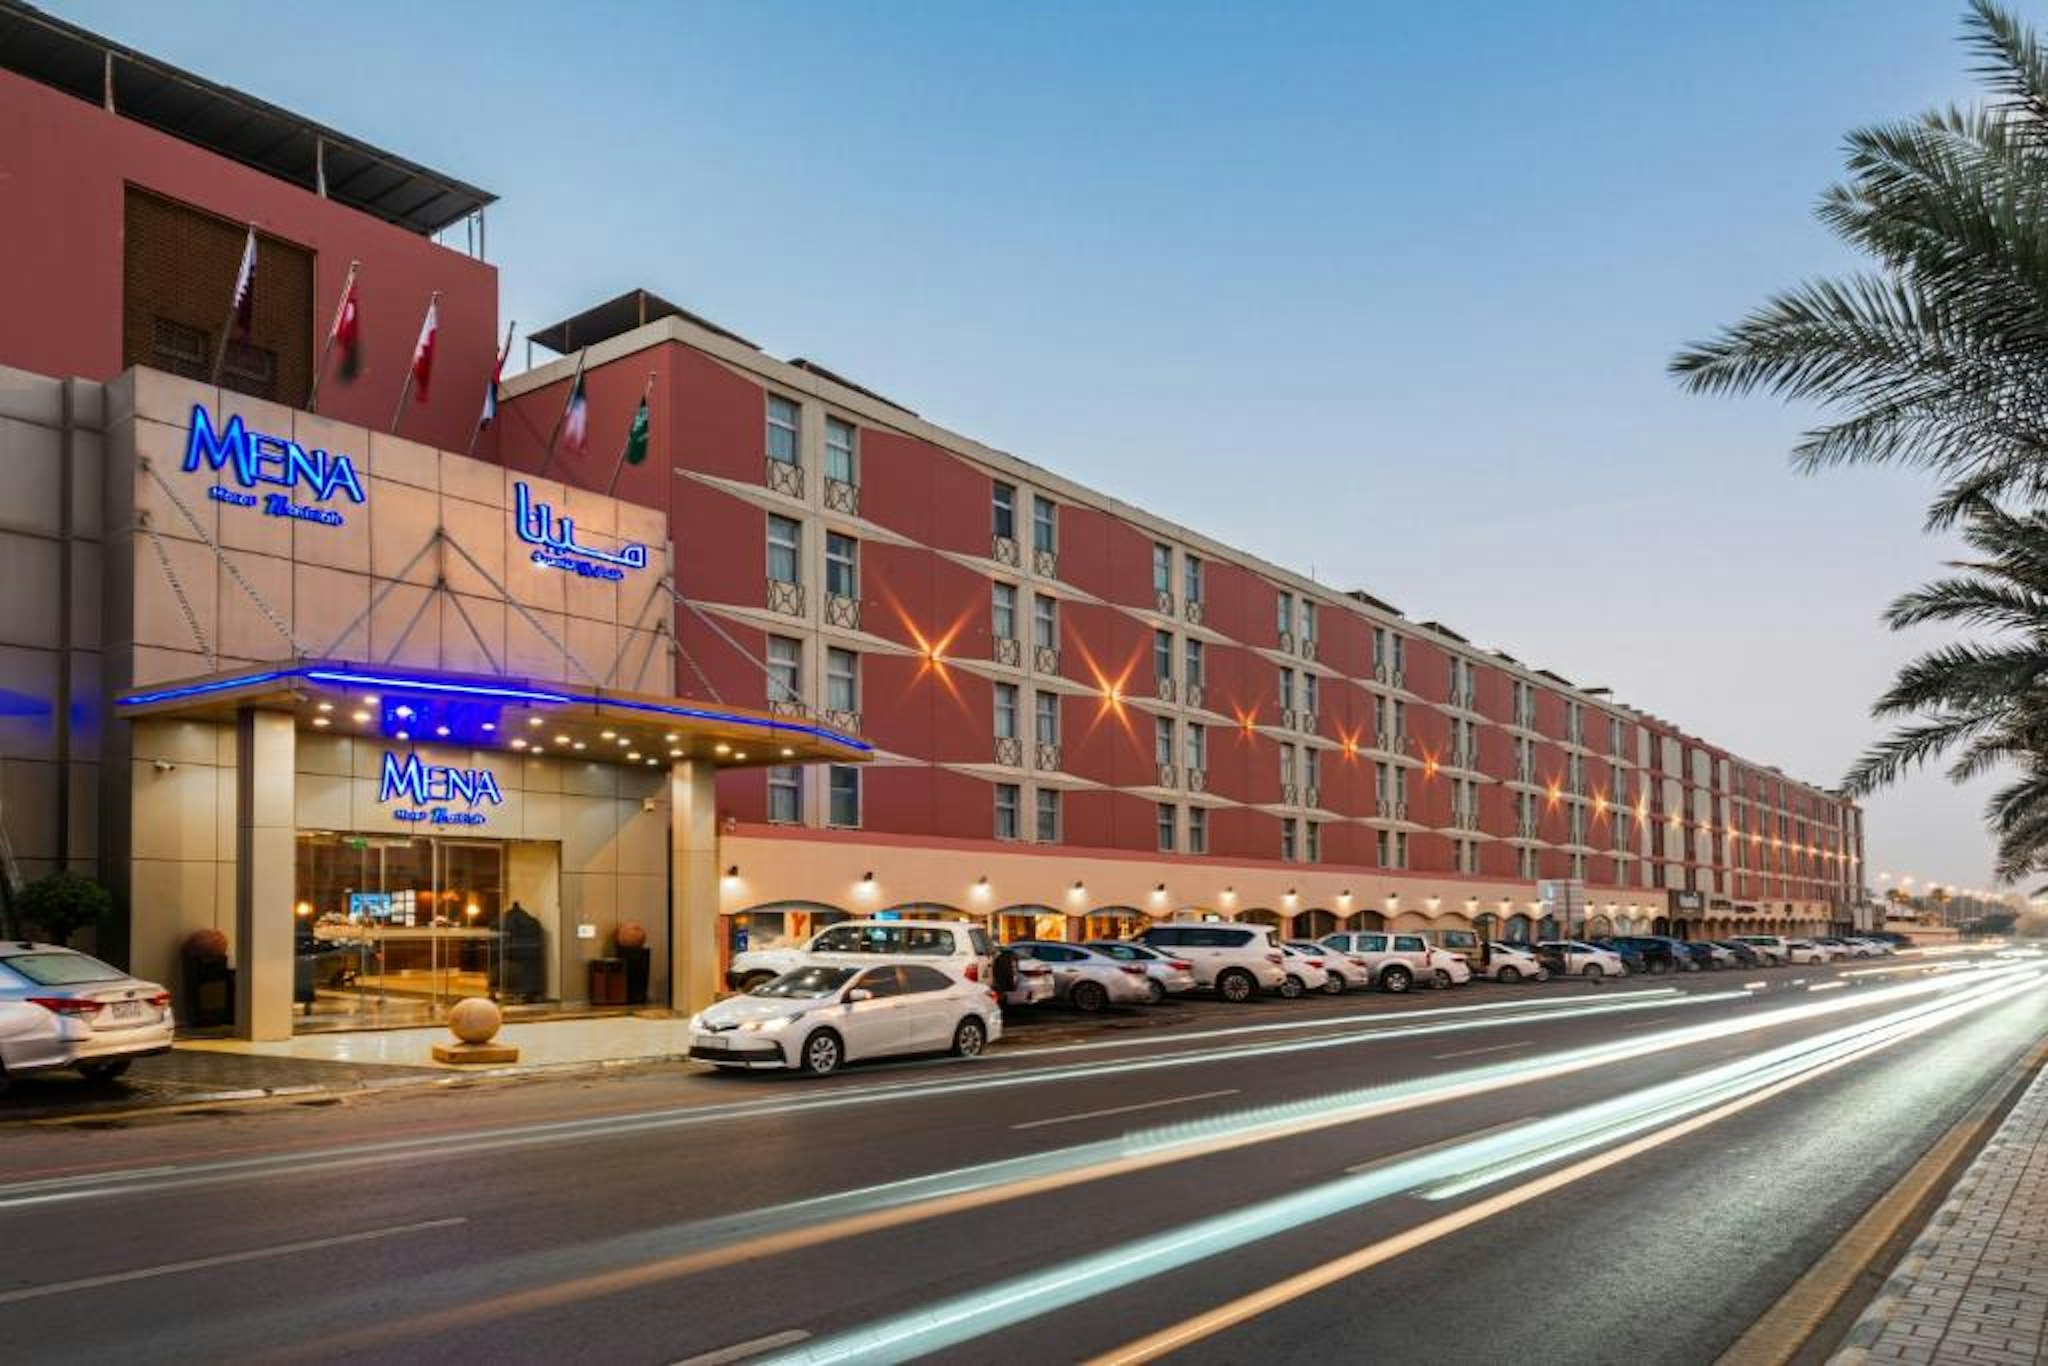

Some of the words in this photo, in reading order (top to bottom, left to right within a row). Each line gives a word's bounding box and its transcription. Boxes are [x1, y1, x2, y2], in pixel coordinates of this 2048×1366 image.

[182, 403, 366, 504] MENA
[514, 481, 647, 569] مينا
[379, 751, 503, 806] MENA
